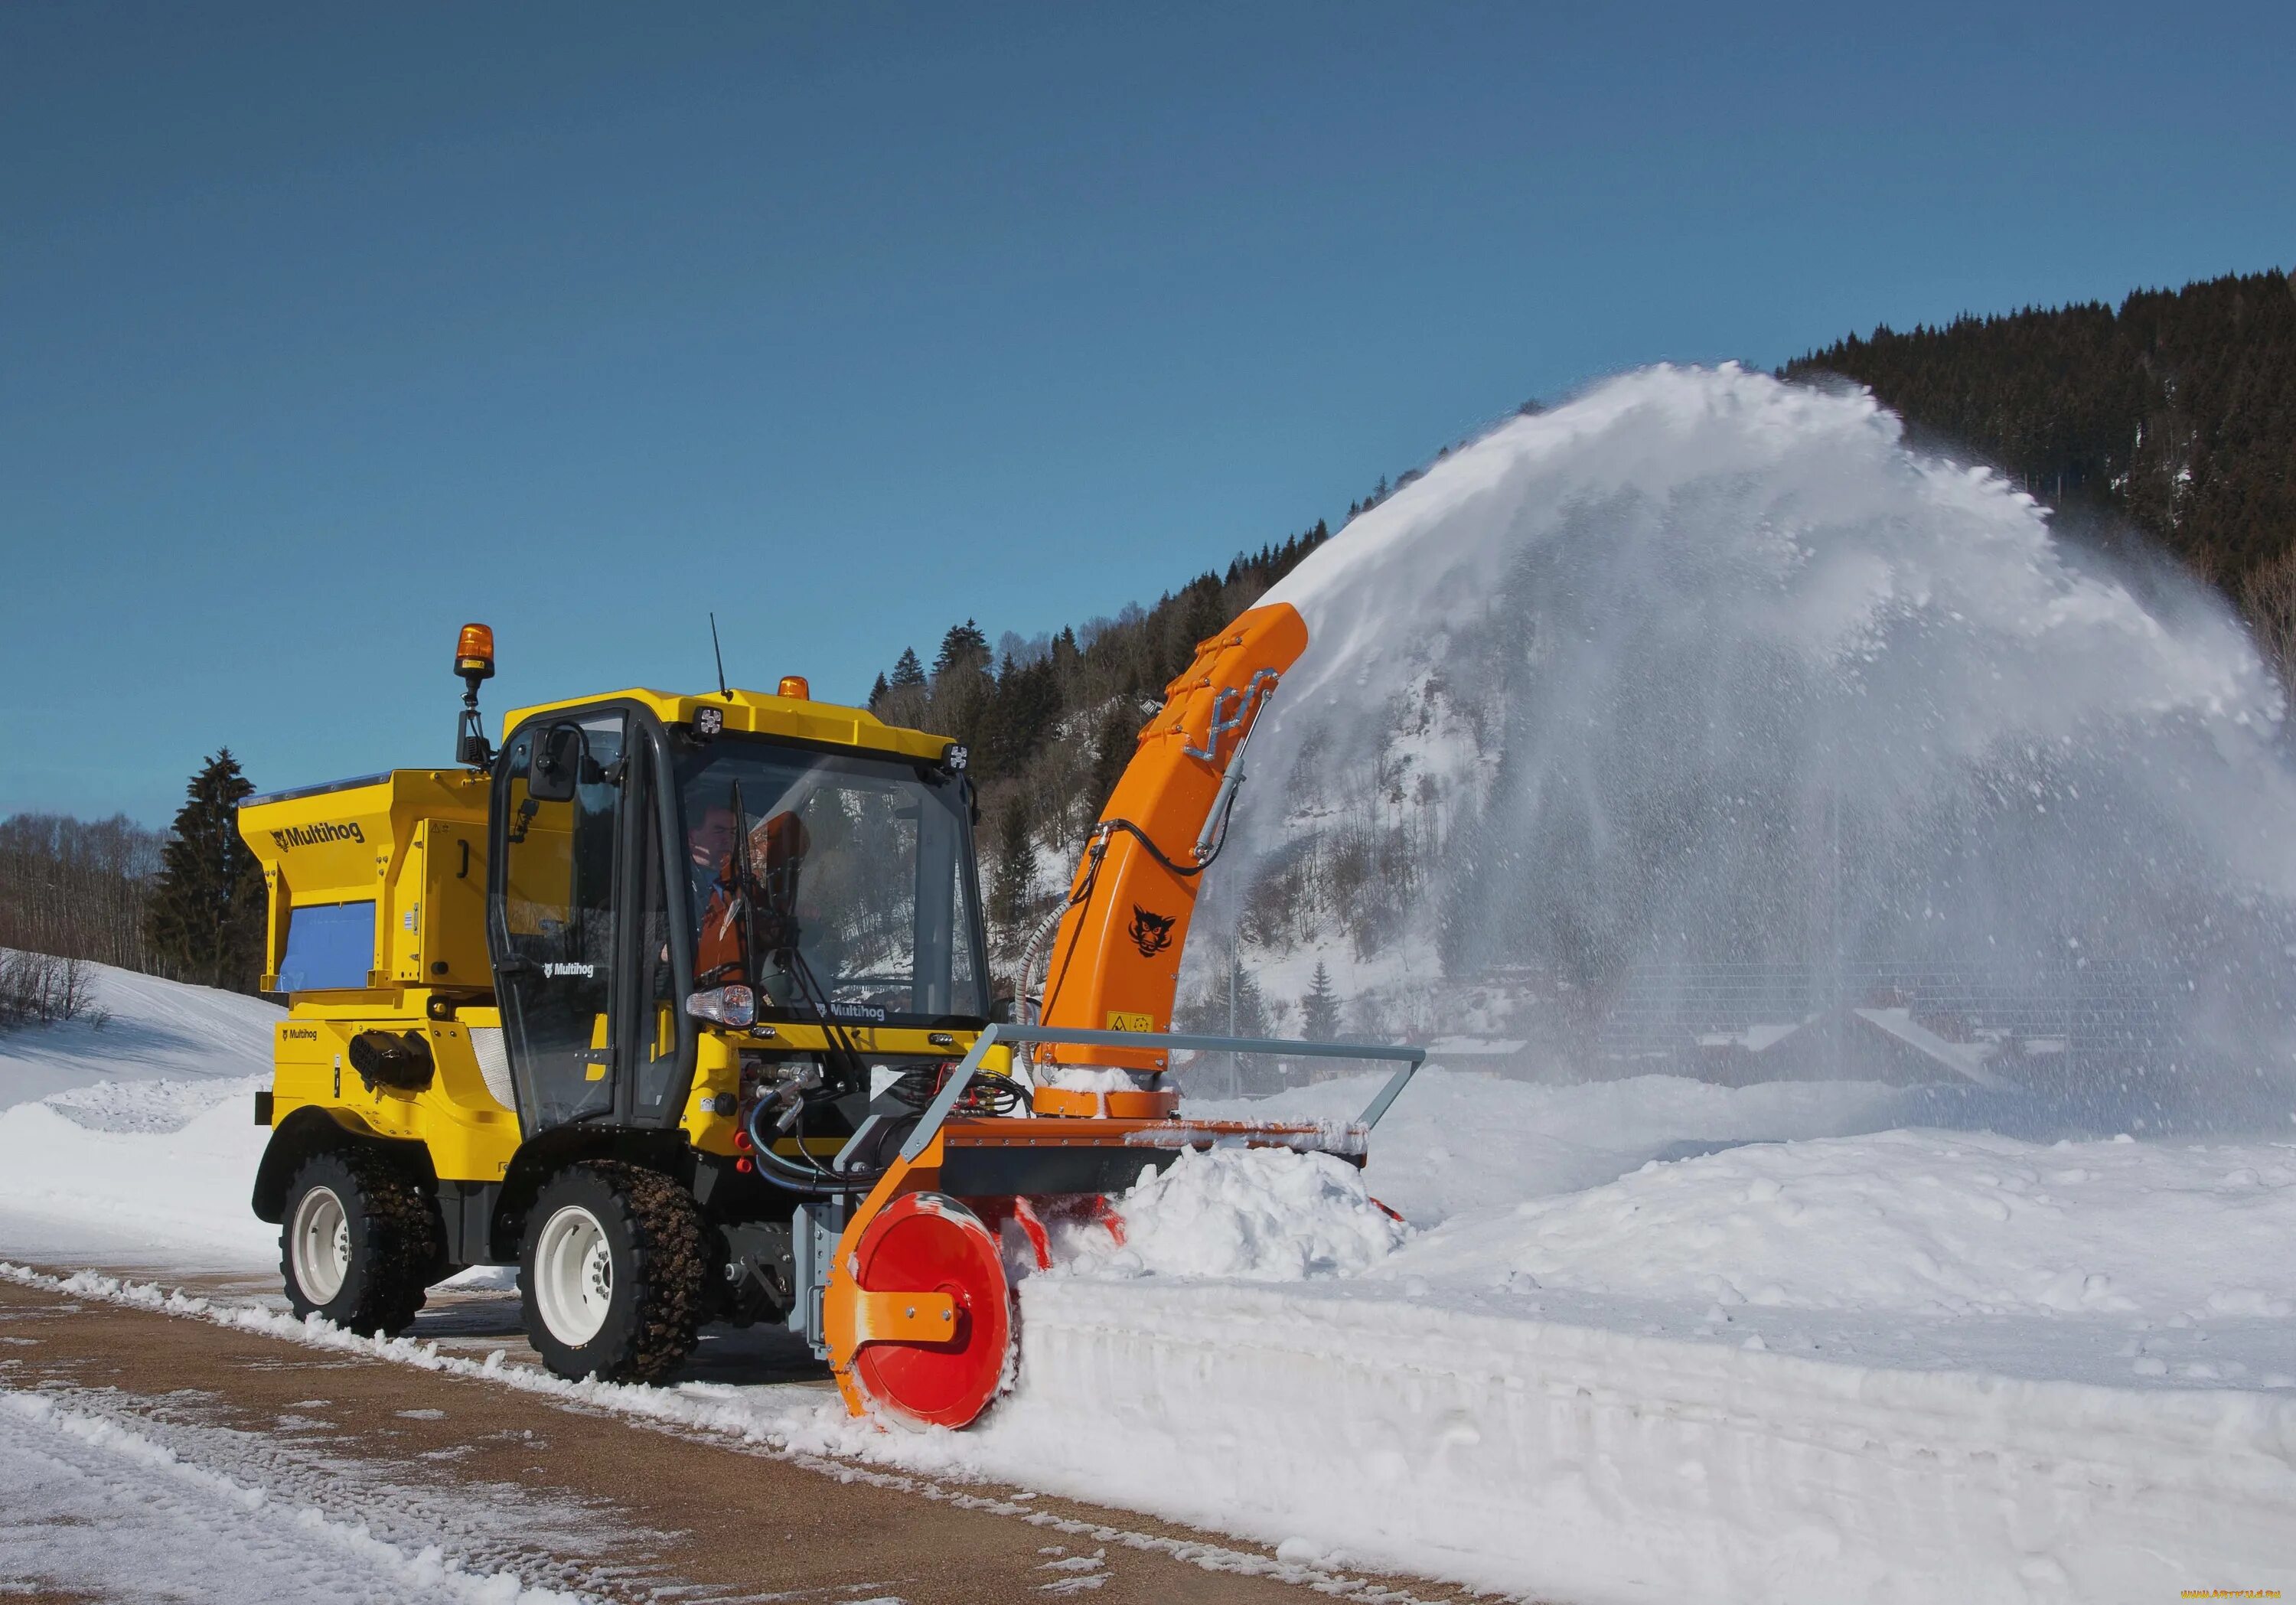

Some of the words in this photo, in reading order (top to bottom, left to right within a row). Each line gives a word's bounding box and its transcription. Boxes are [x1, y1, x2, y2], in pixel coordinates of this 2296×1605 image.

[285, 822, 365, 847] Multihog
[554, 962, 594, 978] Multihog
[830, 1003, 885, 1021] Multihog
[290, 1029, 317, 1041] Multihog
